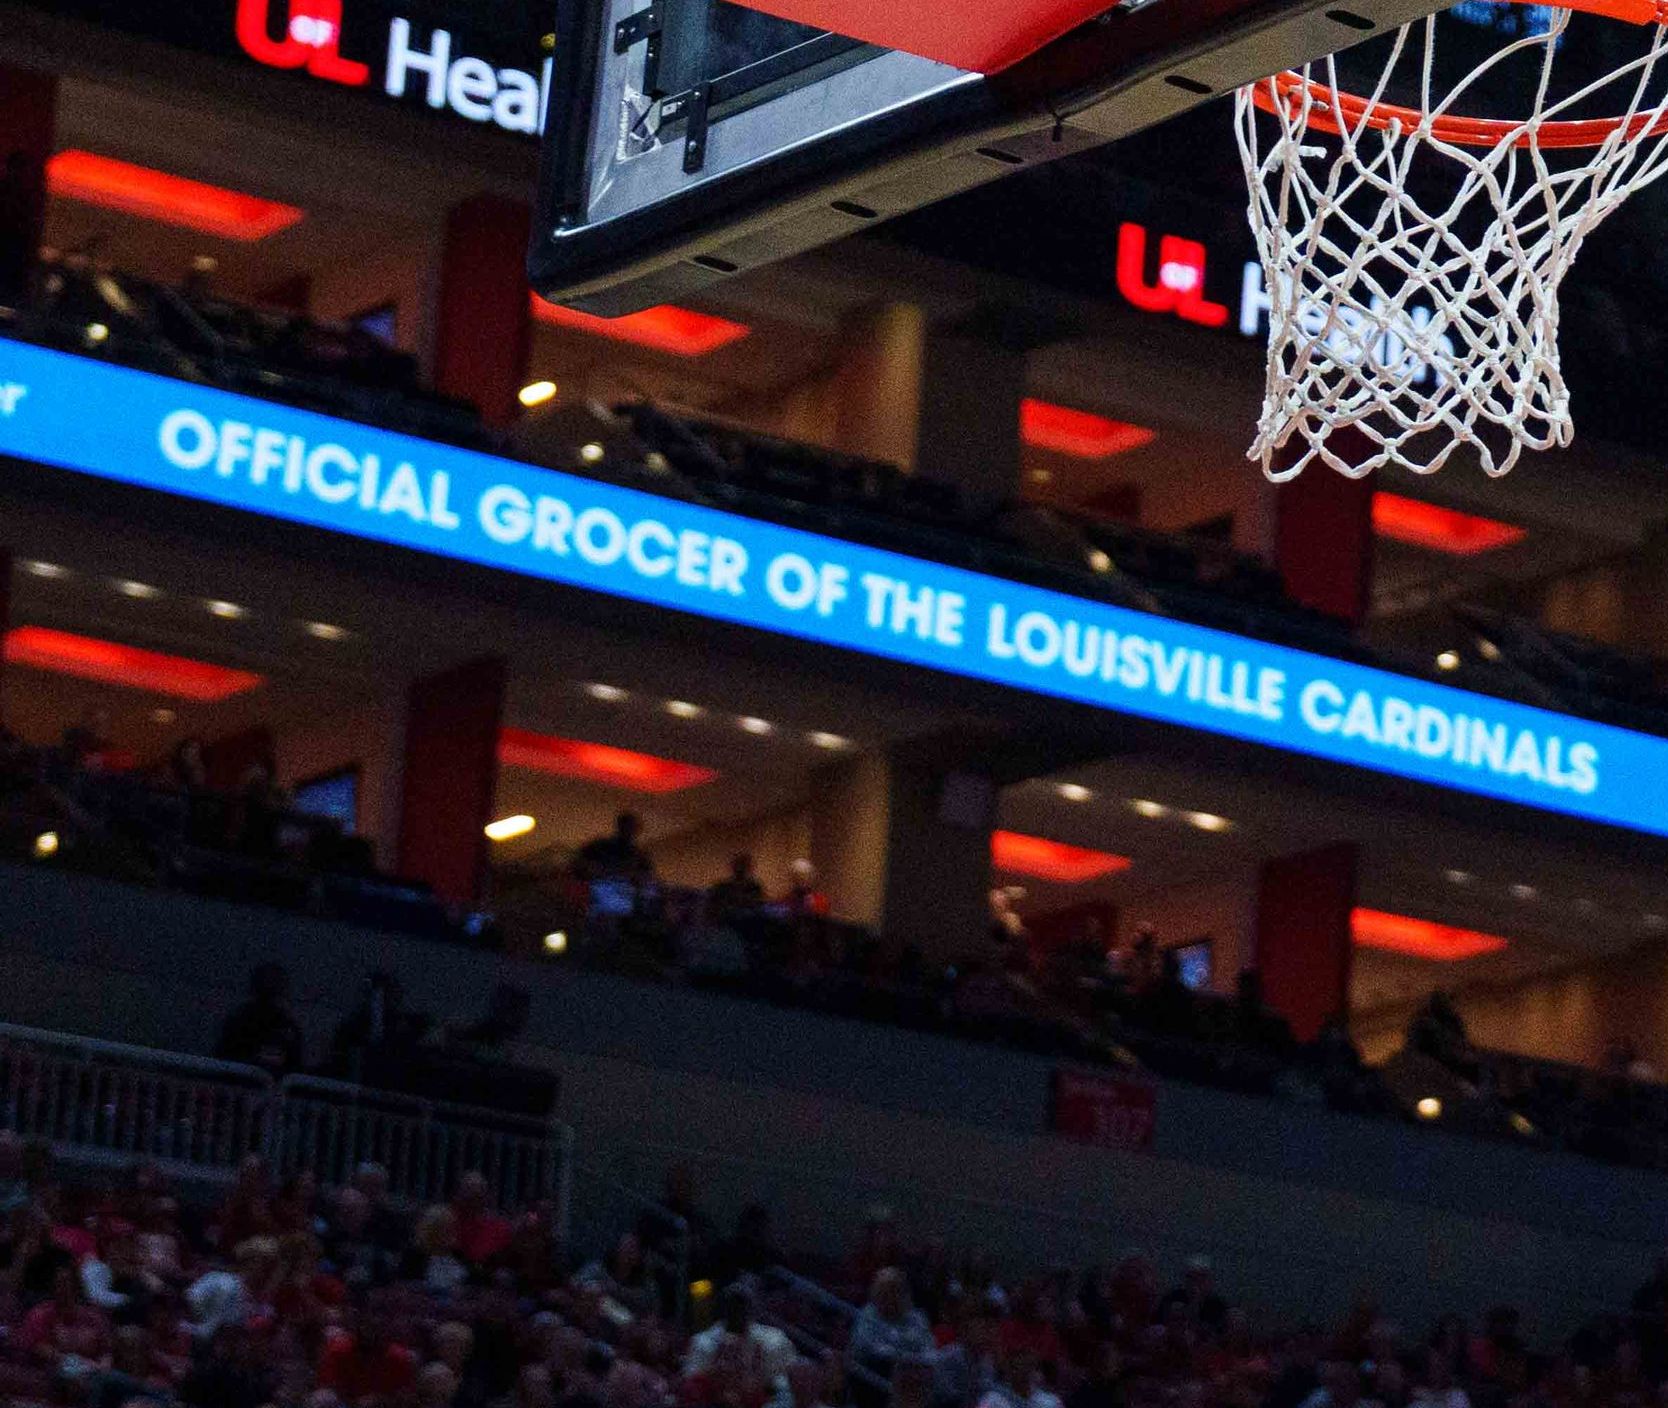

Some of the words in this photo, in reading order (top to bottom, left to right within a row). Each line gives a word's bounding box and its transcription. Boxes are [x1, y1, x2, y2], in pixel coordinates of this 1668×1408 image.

[385, 17, 554, 137] Heal
[158, 407, 461, 531] OFFICIAL
[477, 483, 749, 597] GROCER
[765, 551, 851, 617] OF
[860, 571, 967, 647] THE
[986, 602, 1287, 722] LOUISVILLE
[1299, 678, 1600, 795] CARDINALS
